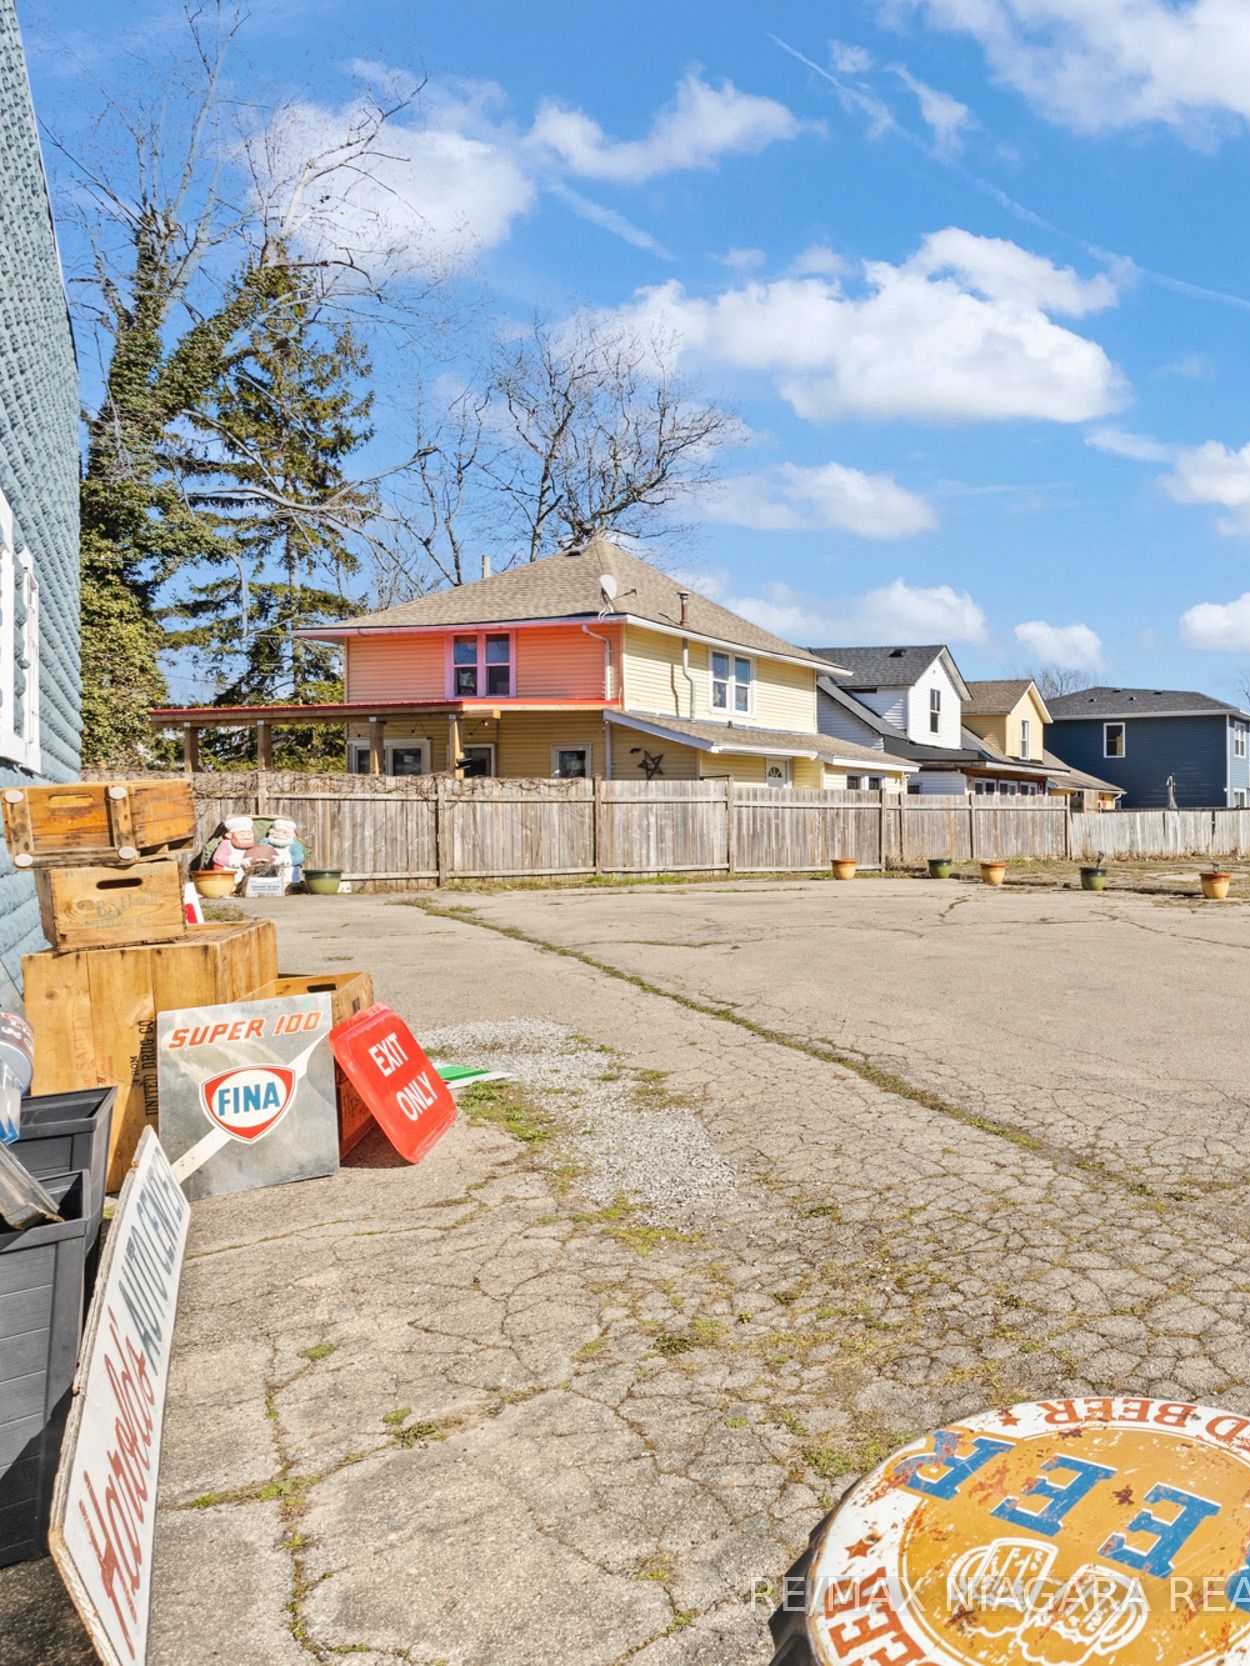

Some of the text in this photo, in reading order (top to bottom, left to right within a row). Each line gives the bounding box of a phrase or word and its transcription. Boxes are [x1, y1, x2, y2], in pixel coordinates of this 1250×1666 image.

[168, 1010, 323, 1050] SUPER 100
[140, 1038, 158, 1071] DRUG
[368, 1031, 409, 1078] EXIT
[143, 1073, 159, 1117] UNITED
[217, 1081, 282, 1118] FINA
[395, 1070, 440, 1123] ONLY
[118, 1224, 169, 1377] AUTO
[1036, 1397, 1198, 1428] BEER
[824, 1566, 942, 1666] EER
